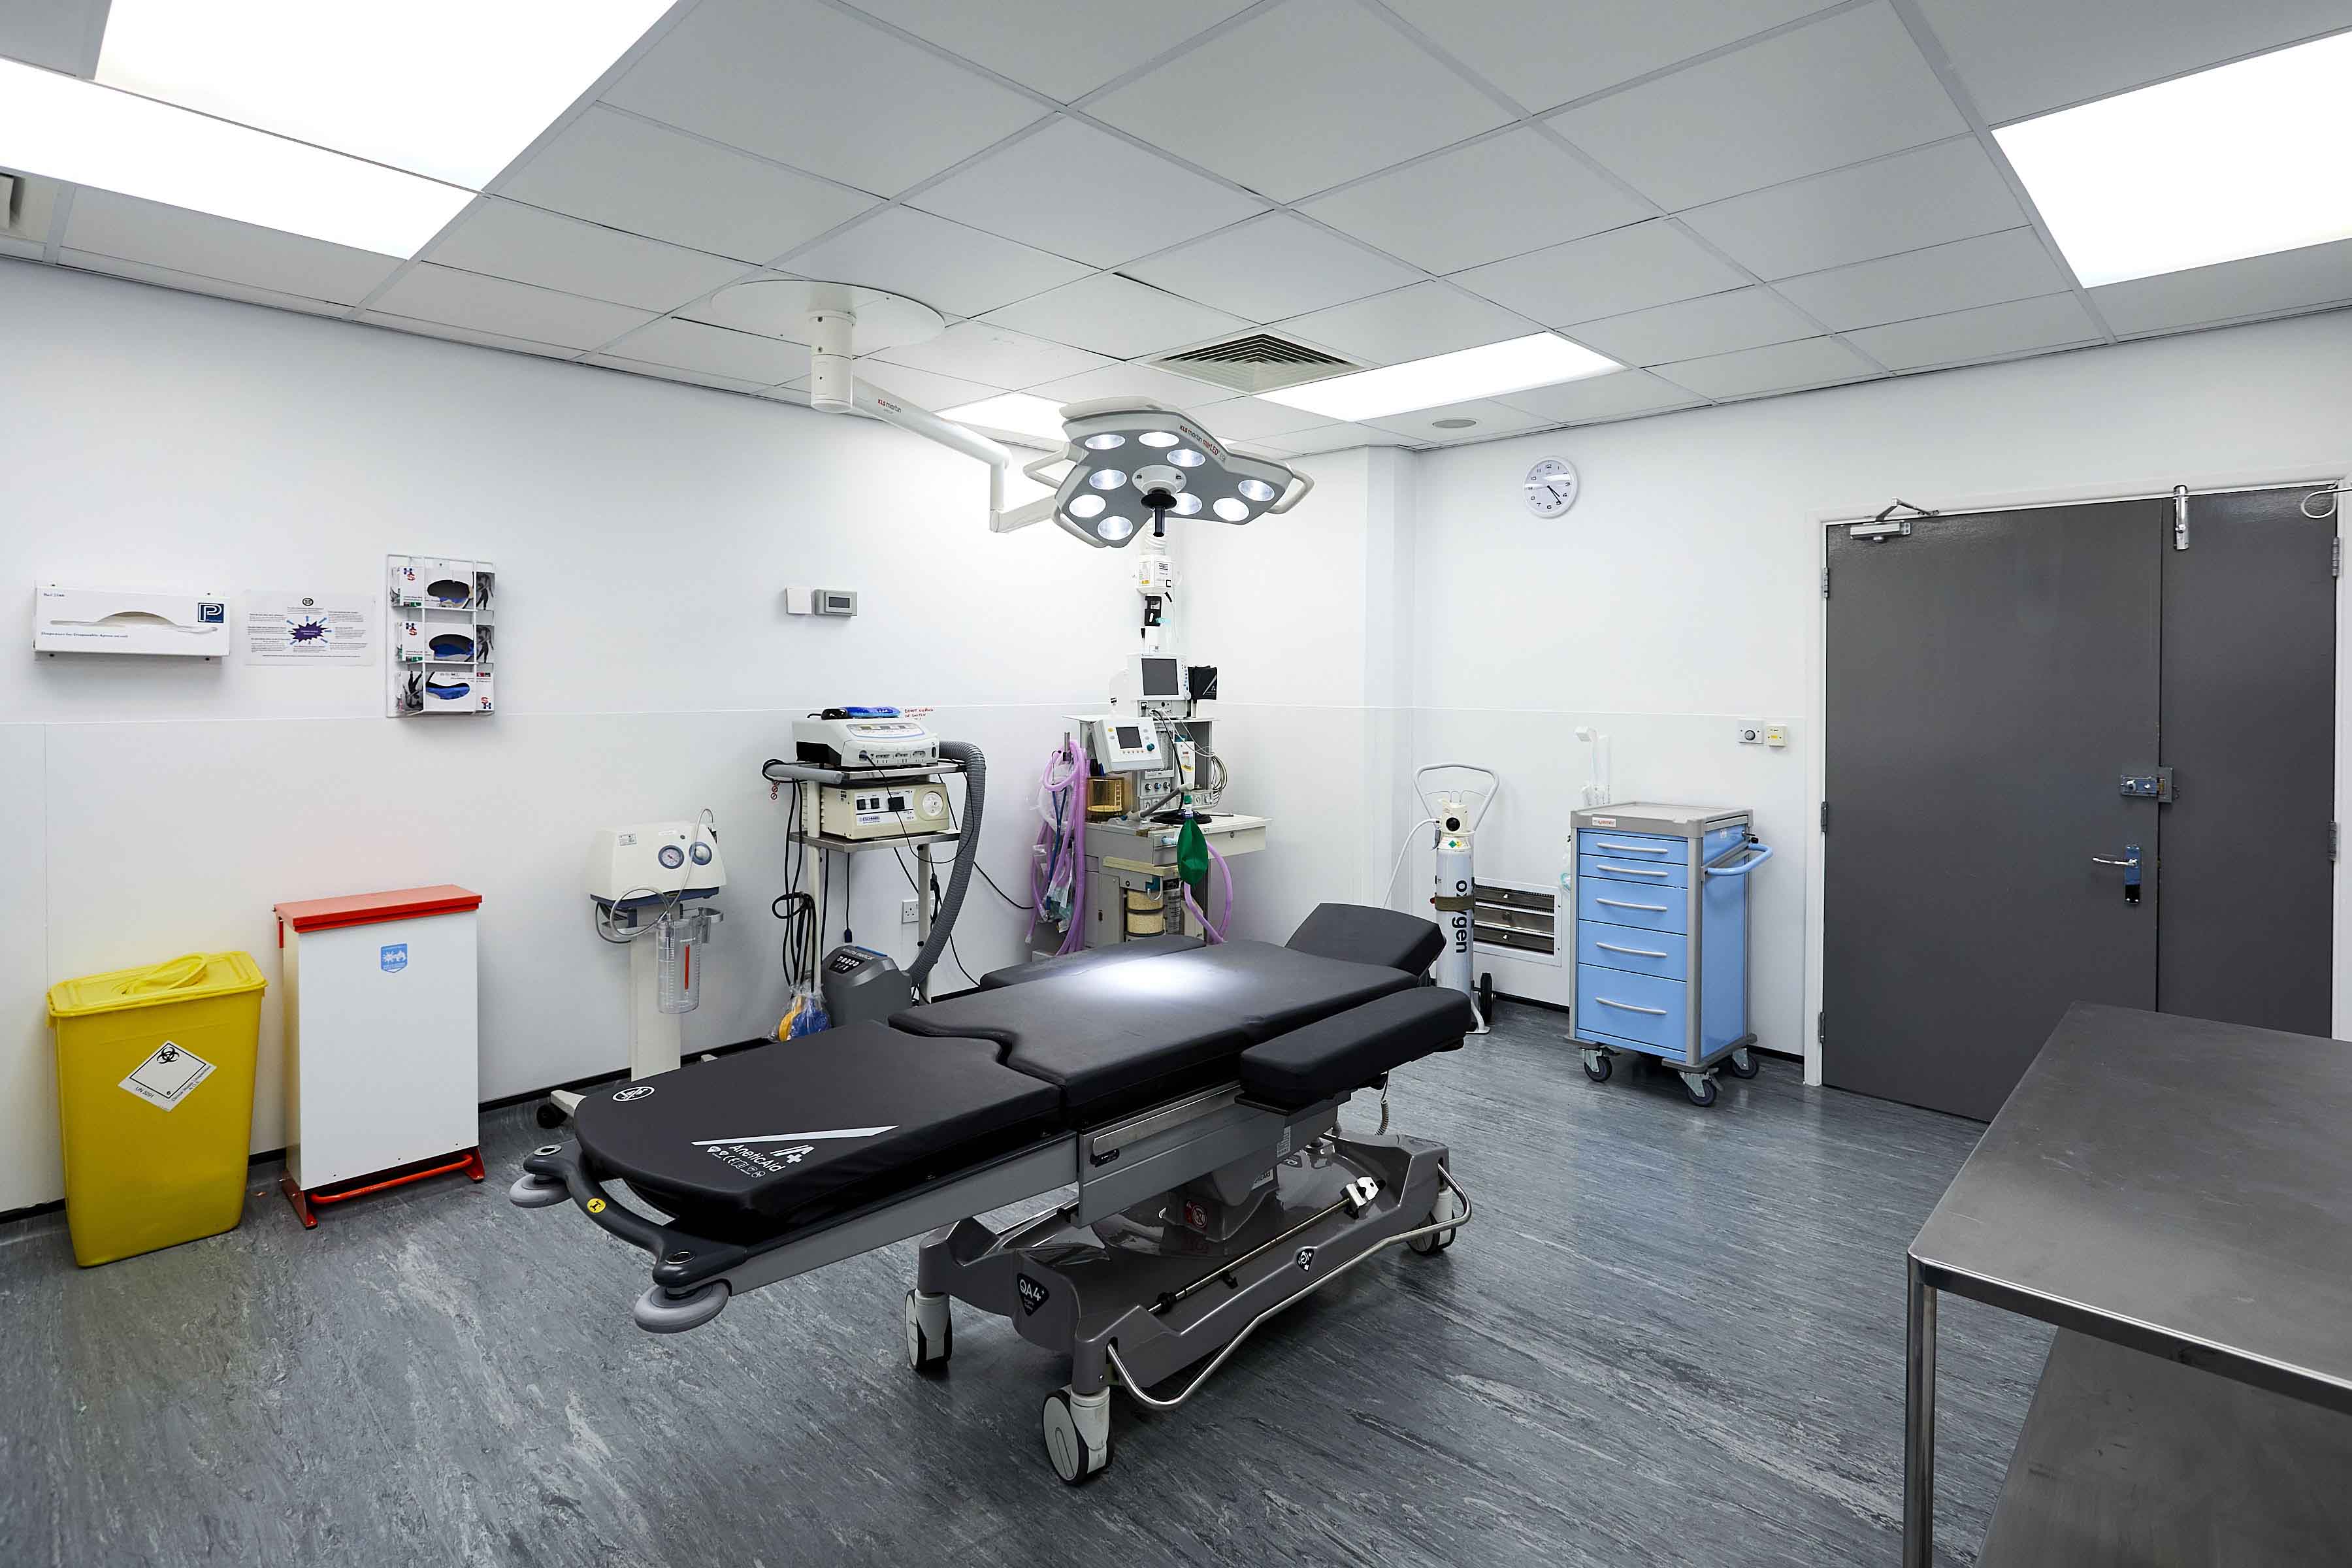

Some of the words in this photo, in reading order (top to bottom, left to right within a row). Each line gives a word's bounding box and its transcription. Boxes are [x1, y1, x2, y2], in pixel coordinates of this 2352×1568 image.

[886, 402, 902, 413] martin
[1187, 429, 1203, 443] martin
[142, 1090, 155, 1099] 3291
[728, 1144, 787, 1172] AneticAid
[1019, 1279, 1042, 1301] QA4
